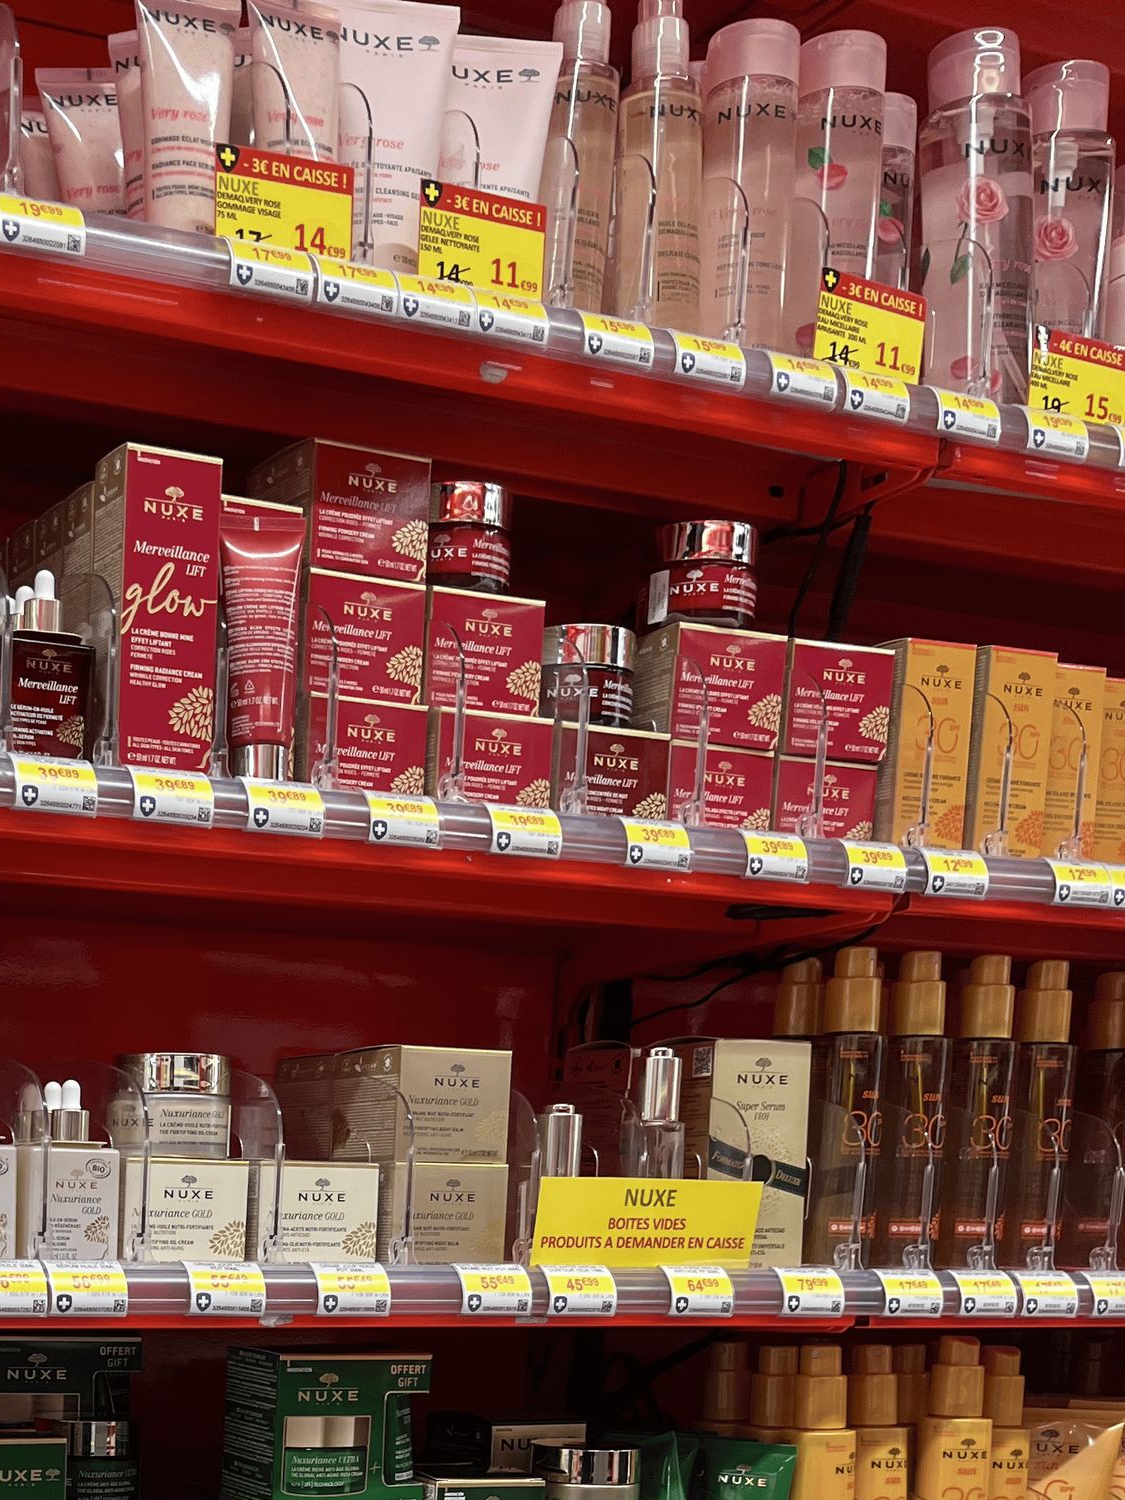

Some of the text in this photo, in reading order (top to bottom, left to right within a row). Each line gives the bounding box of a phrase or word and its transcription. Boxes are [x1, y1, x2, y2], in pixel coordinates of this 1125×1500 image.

[718, 104, 787, 124] NUXE
[251, 158, 337, 186] 3€ EN CAISSE
[218, 176, 260, 197] NUXE
[19, 201, 64, 217] 19€99
[217, 203, 282, 219] GOMMAGE VISAGE
[260, 199, 282, 209] ROSE
[422, 209, 461, 230] NUXE
[420, 237, 481, 253] GELEE NETTOYANTE
[821, 294, 852, 314] NUXE
[144, 503, 204, 522] NUXE
[134, 540, 210, 563] Merveillance
[186, 564, 207, 577] LIFT
[122, 563, 218, 634] glow
[710, 656, 756, 672] NUXE
[920, 676, 962, 690] NUXE
[942, 857, 973, 873] 12€99
[738, 1072, 788, 1085] NUXE
[736, 1101, 785, 1113] Super Serum
[625, 1188, 677, 1207] NUXE
[608, 1217, 686, 1229] BOITES VIDES
[540, 1236, 745, 1250] PRODUITS A DEMANDER EN CAISSE
[566, 1278, 599, 1291] 45€99
[687, 1278, 719, 1291] 64€99
[391, 1365, 426, 1376] OFFERT
[398, 1377, 418, 1387] GIFT
[298, 1390, 359, 1401] NUXE
[942, 1450, 987, 1459] NUXE
[717, 1475, 767, 1487] NUXE
